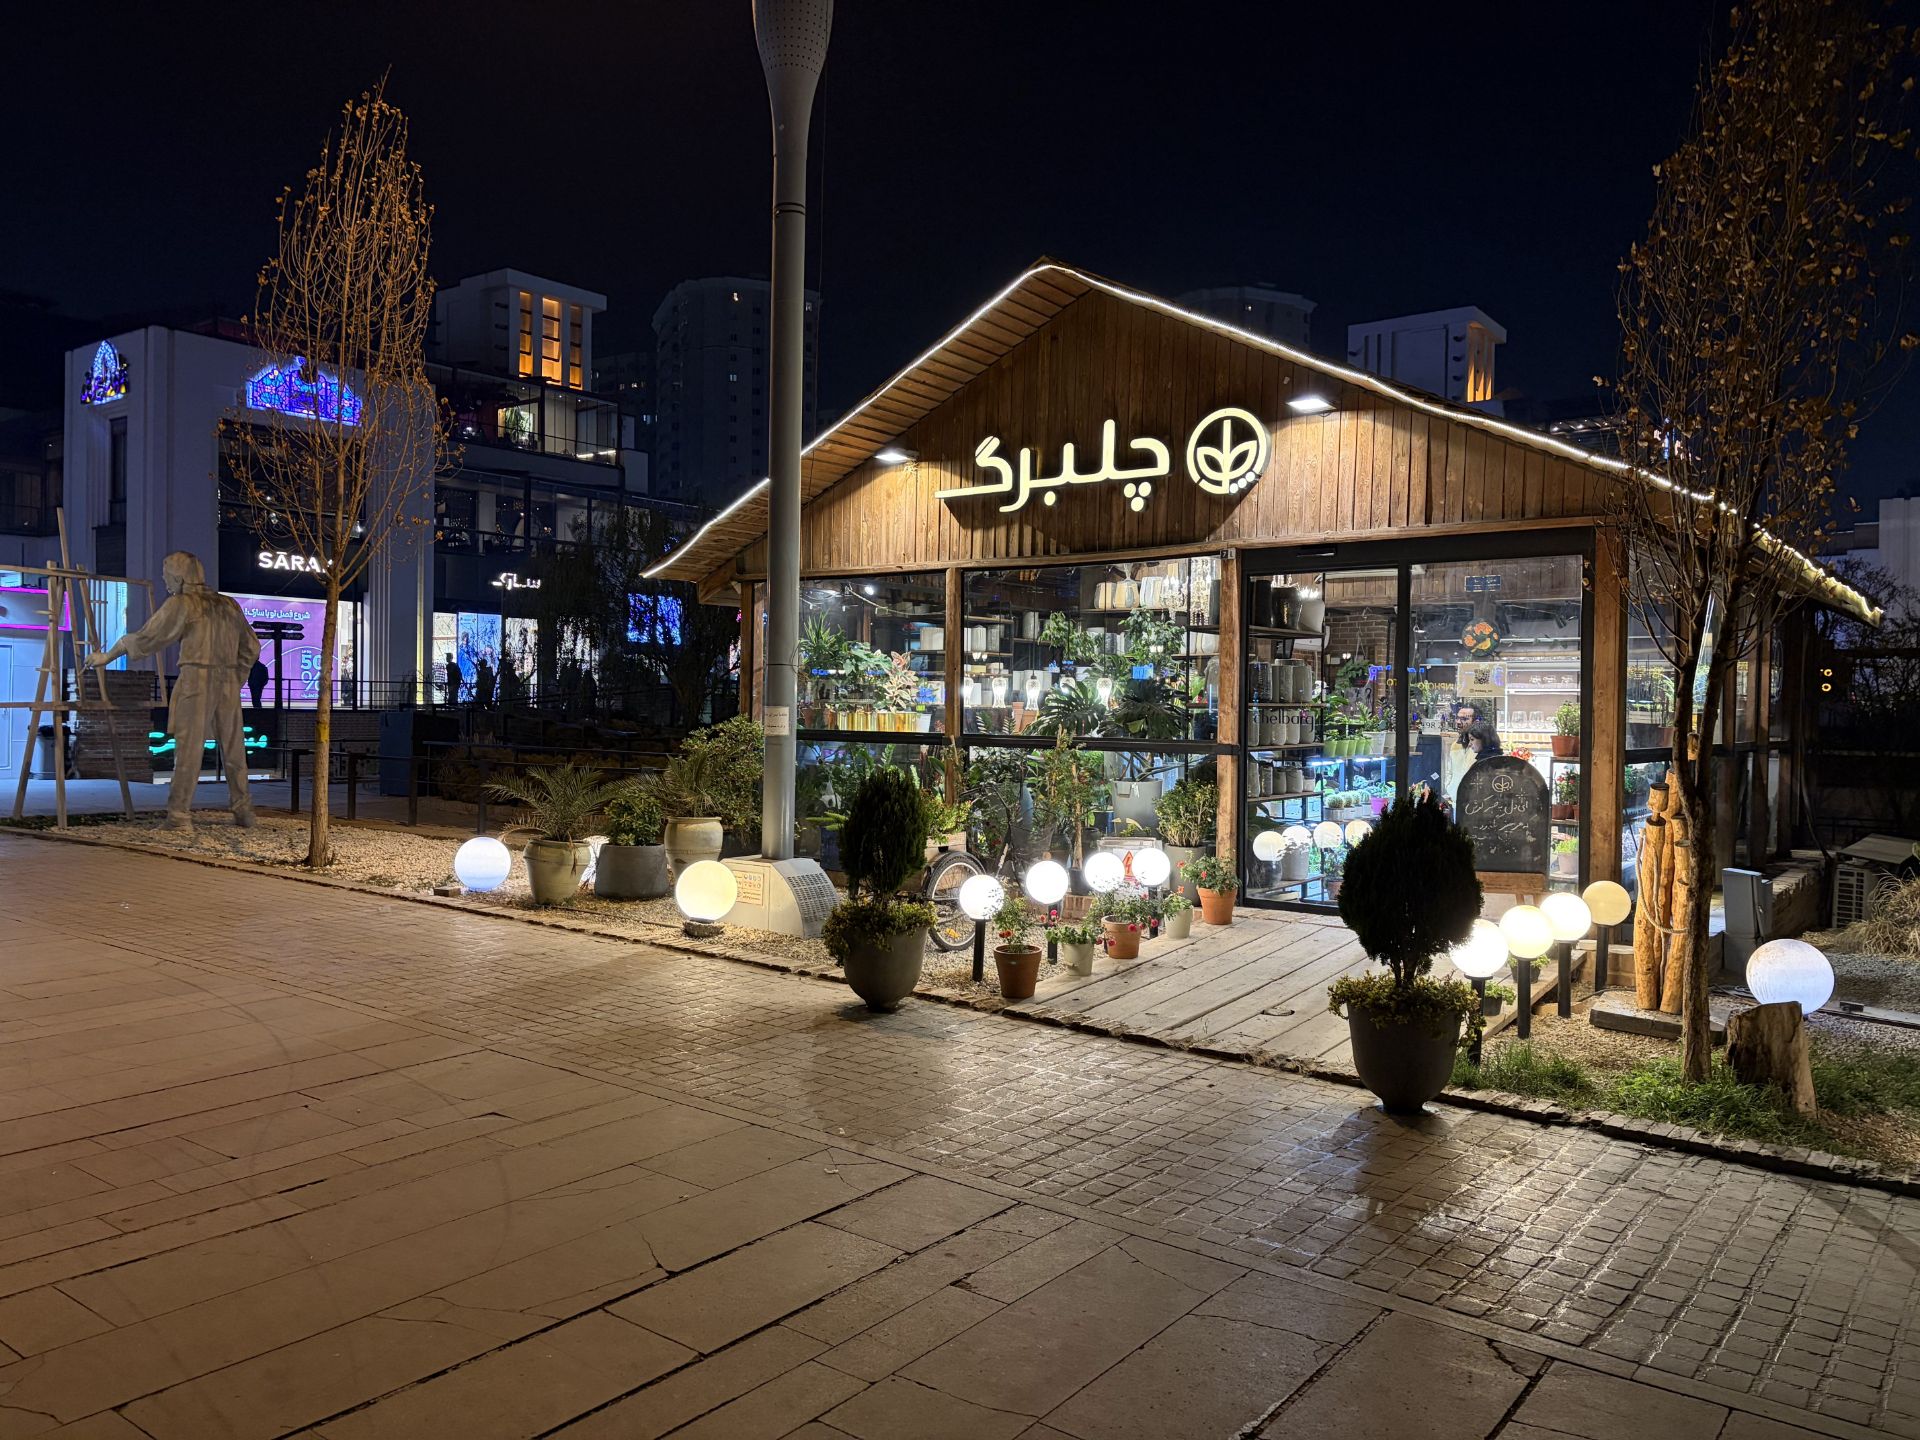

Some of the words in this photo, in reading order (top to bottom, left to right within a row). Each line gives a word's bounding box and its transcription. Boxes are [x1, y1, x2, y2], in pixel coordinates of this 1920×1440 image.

[934, 417, 1171, 513] چلبرگ
[258, 551, 333, 573] SĀRA
[277, 610, 294, 618] فصل
[294, 612, 311, 621] شروع
[1253, 708, 1314, 732] chelbarg
[1504, 799, 1518, 815] دل
